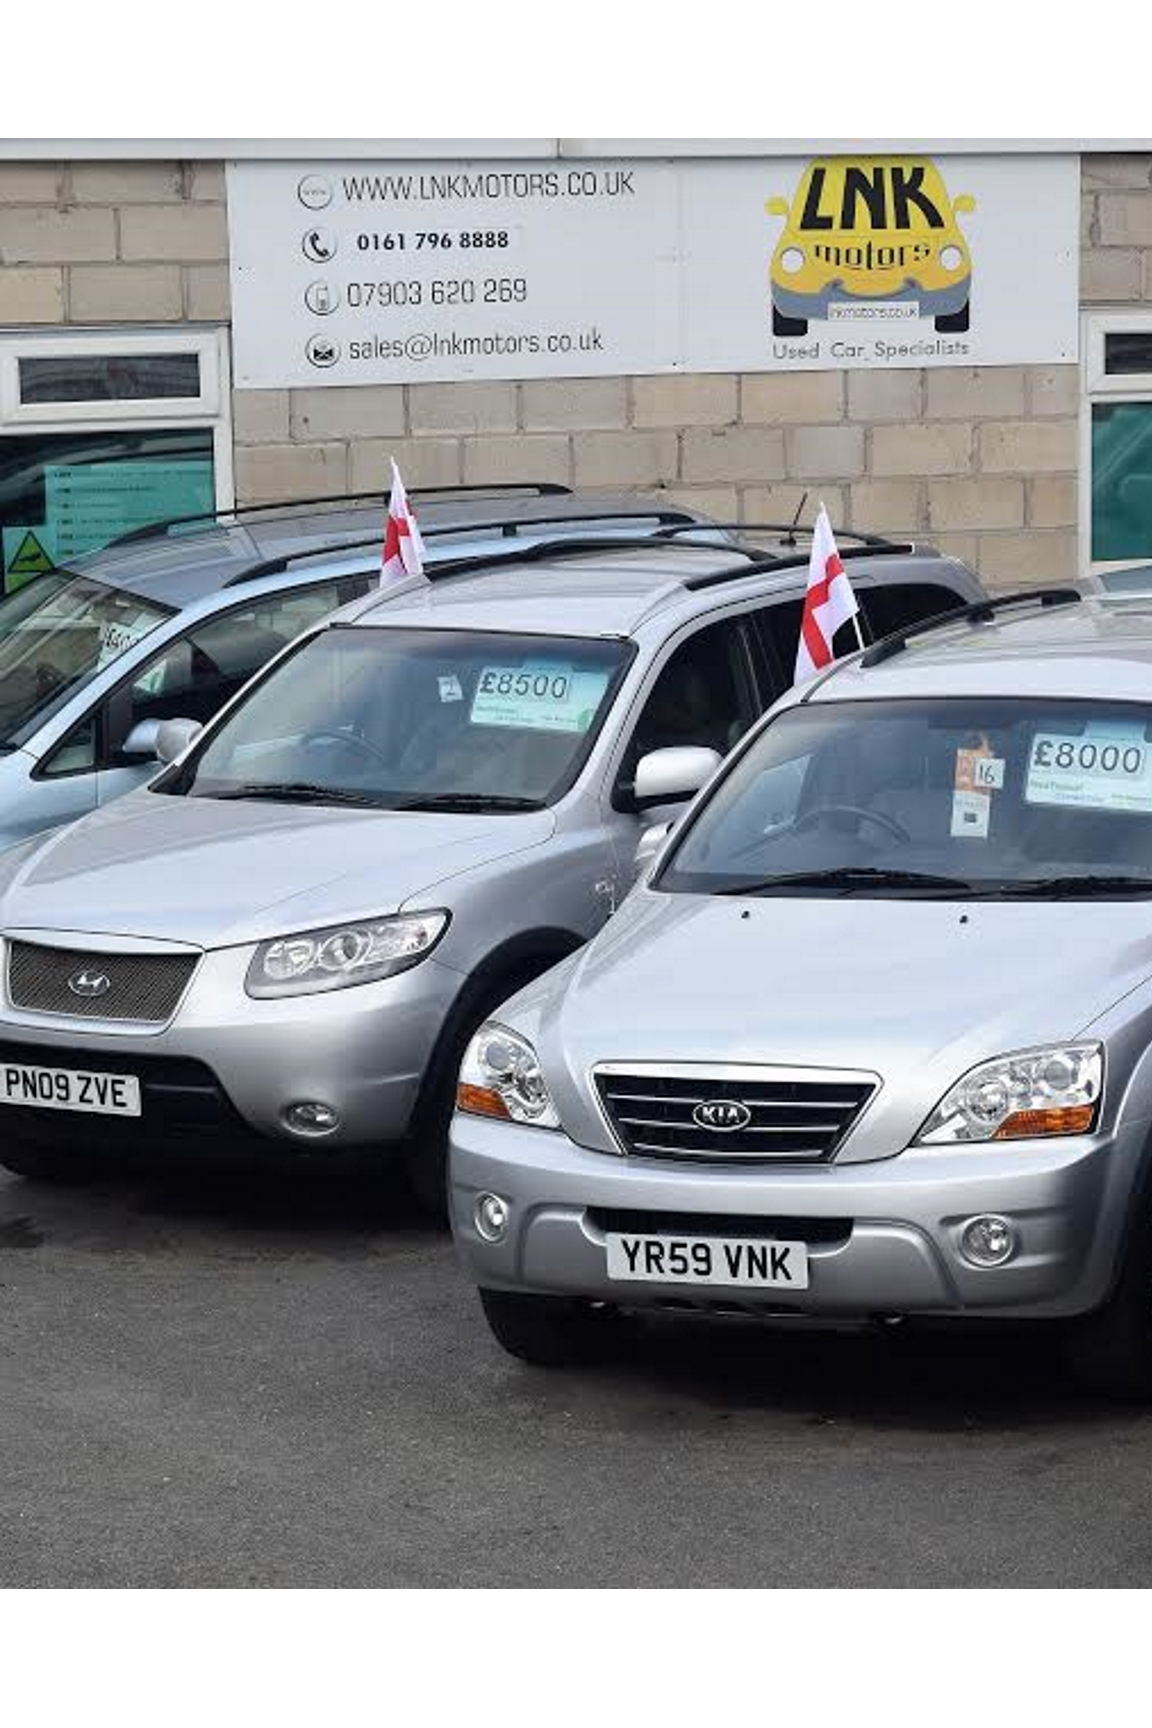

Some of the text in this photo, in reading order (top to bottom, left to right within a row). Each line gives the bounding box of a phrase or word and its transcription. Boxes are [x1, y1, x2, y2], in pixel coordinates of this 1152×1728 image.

[342, 171, 636, 201] WWW.LNKMOTORS.CO.UK
[800, 167, 945, 229] LNK
[357, 231, 508, 250] 0161 796 8888
[814, 241, 930, 270] motors
[347, 278, 527, 307] 07903 620 269
[349, 327, 604, 362] sales@lnkmotors.co.uk
[772, 339, 969, 361] Used Car Specialists
[480, 672, 567, 699] £8500
[1034, 740, 1141, 773] £8000
[979, 763, 995, 785] 16
[6, 1068, 127, 1108] PN09 ZVE
[702, 1106, 740, 1123] KIA
[621, 1239, 792, 1281] YR59 VNK
